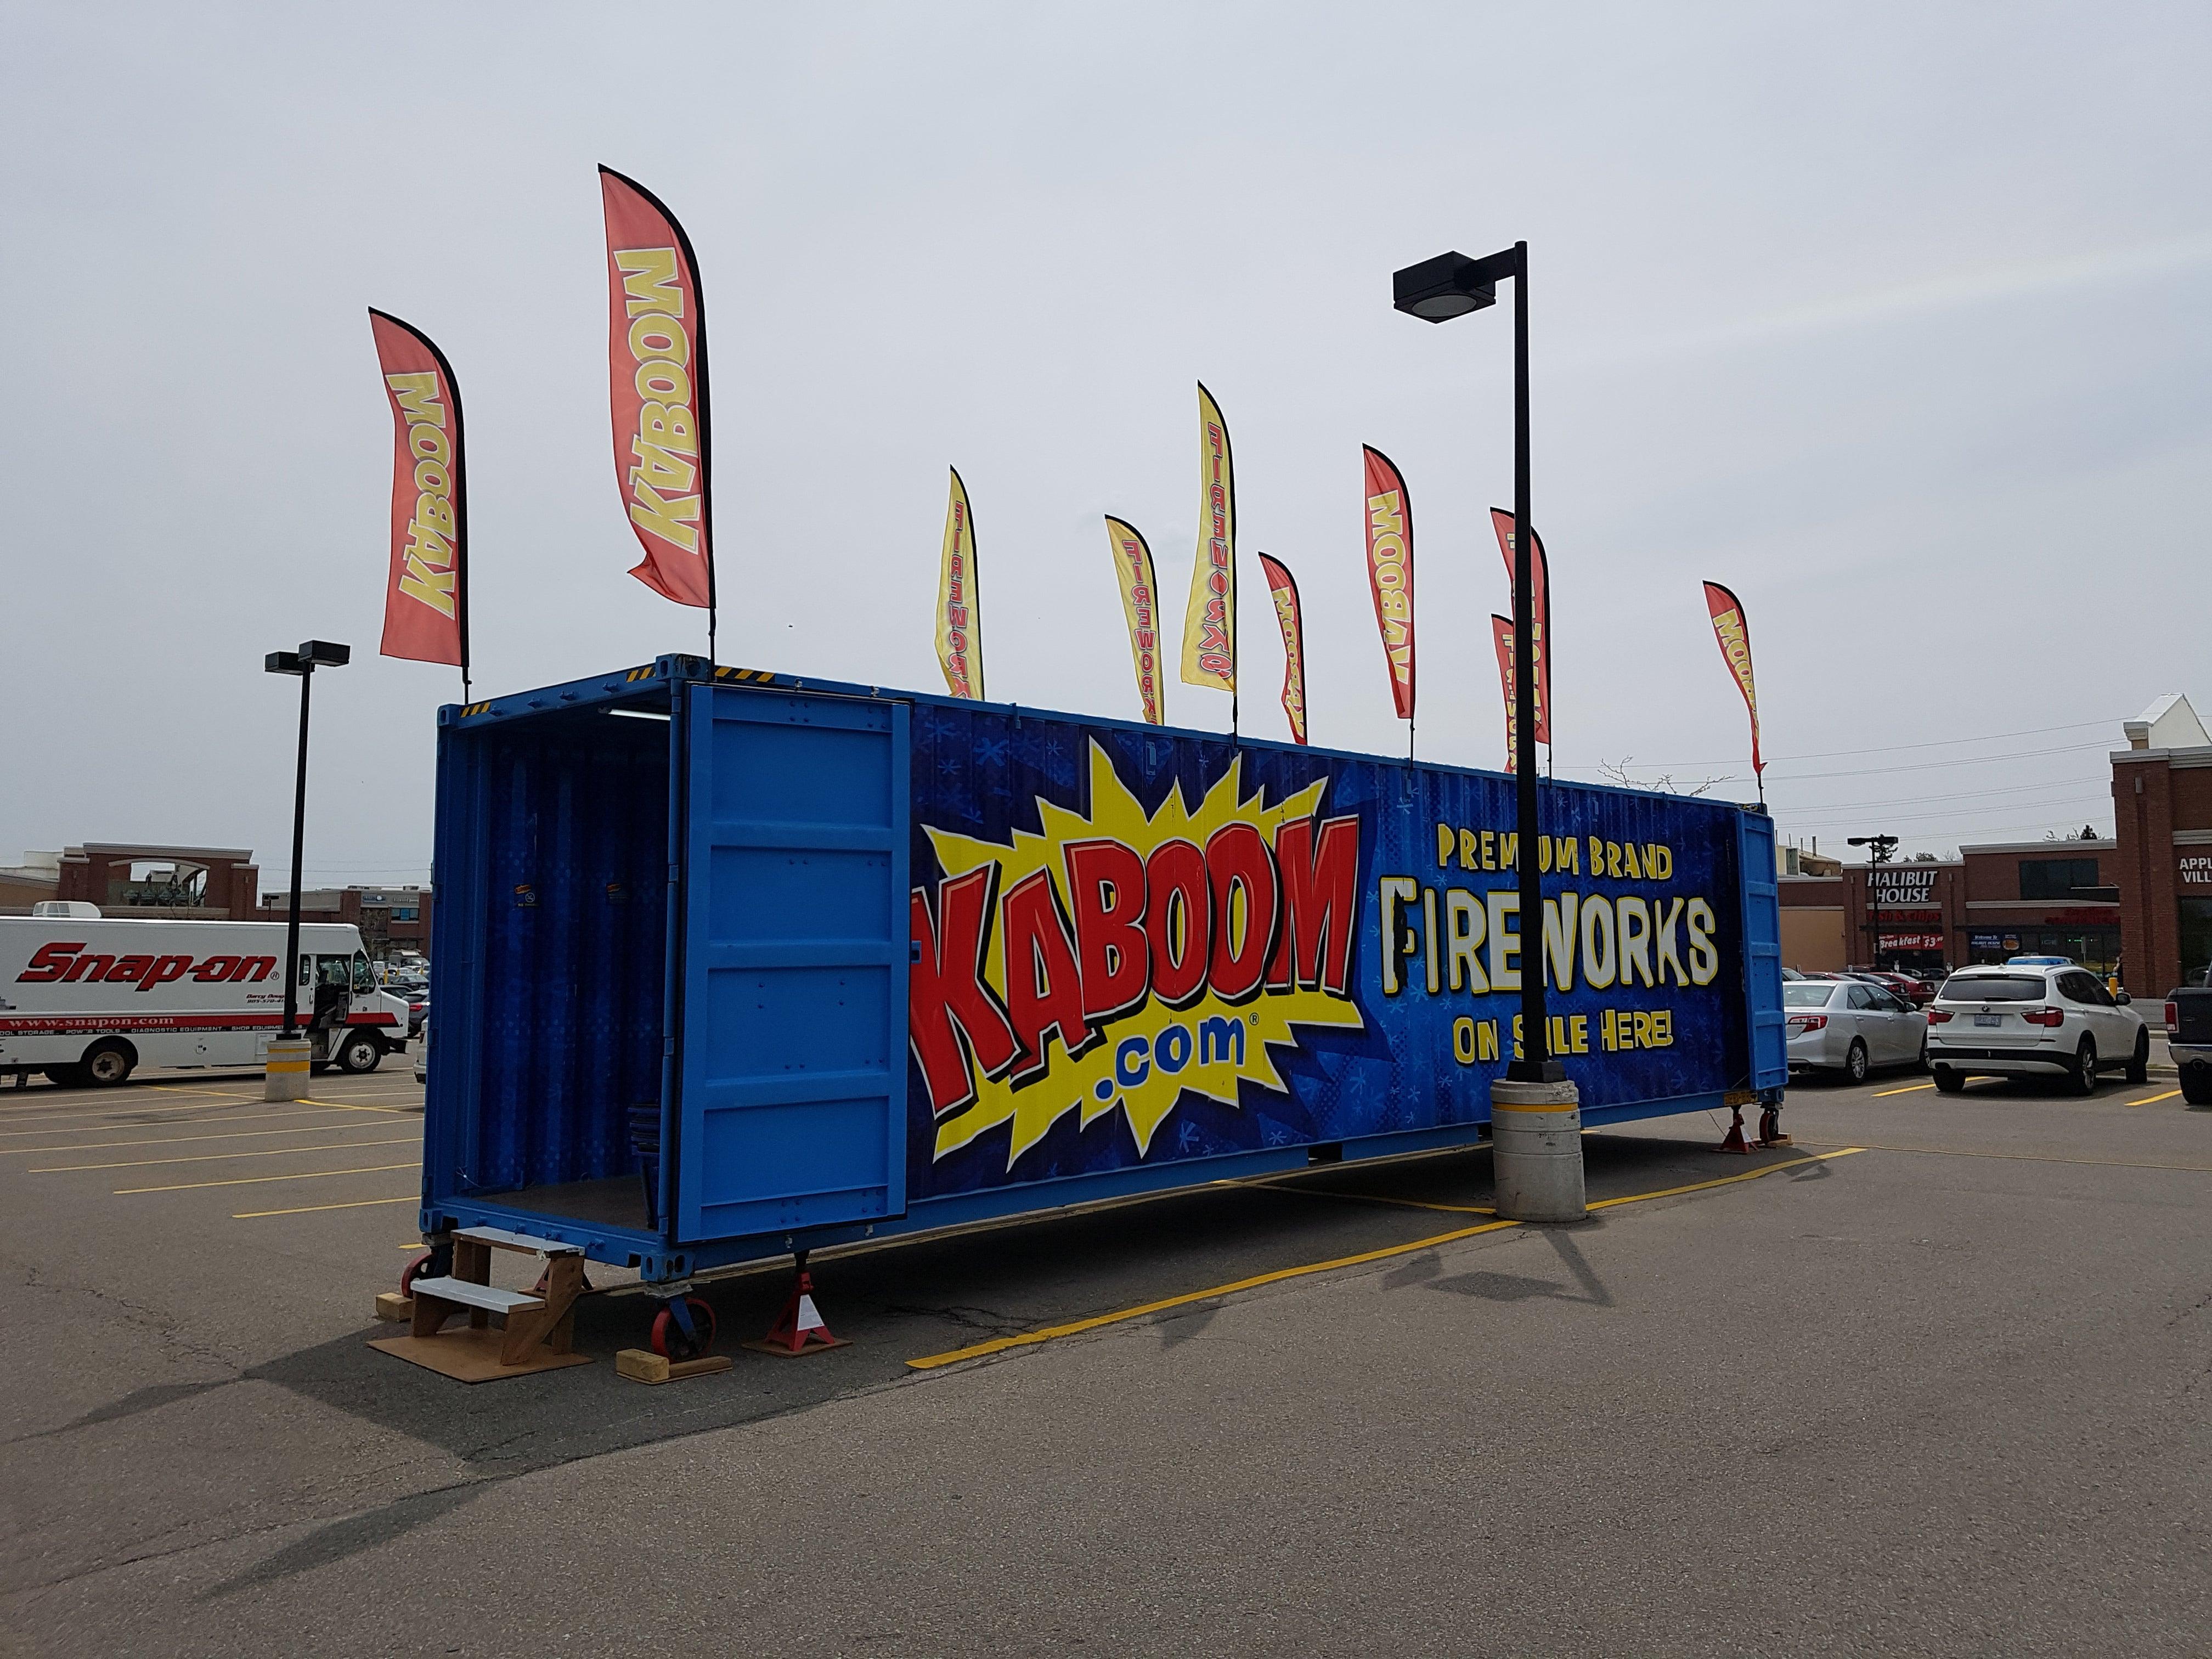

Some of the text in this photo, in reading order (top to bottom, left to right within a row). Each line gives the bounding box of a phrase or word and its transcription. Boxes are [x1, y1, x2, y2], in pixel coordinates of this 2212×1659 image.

[1437, 823, 1673, 880] PREMUM BRAND
[1867, 871, 1938, 887] HALIBUT
[1876, 888, 1929, 902] HOUSE
[1380, 877, 1719, 995] FIREWORKS
[16, 943, 277, 991] Snap-on
[911, 813, 1359, 1119] KABOOM
[9, 1016, 174, 1028] www.snapon.com
[1453, 1010, 1674, 1064] ON SLE HERE!
[1094, 1015, 1245, 1103] .com
